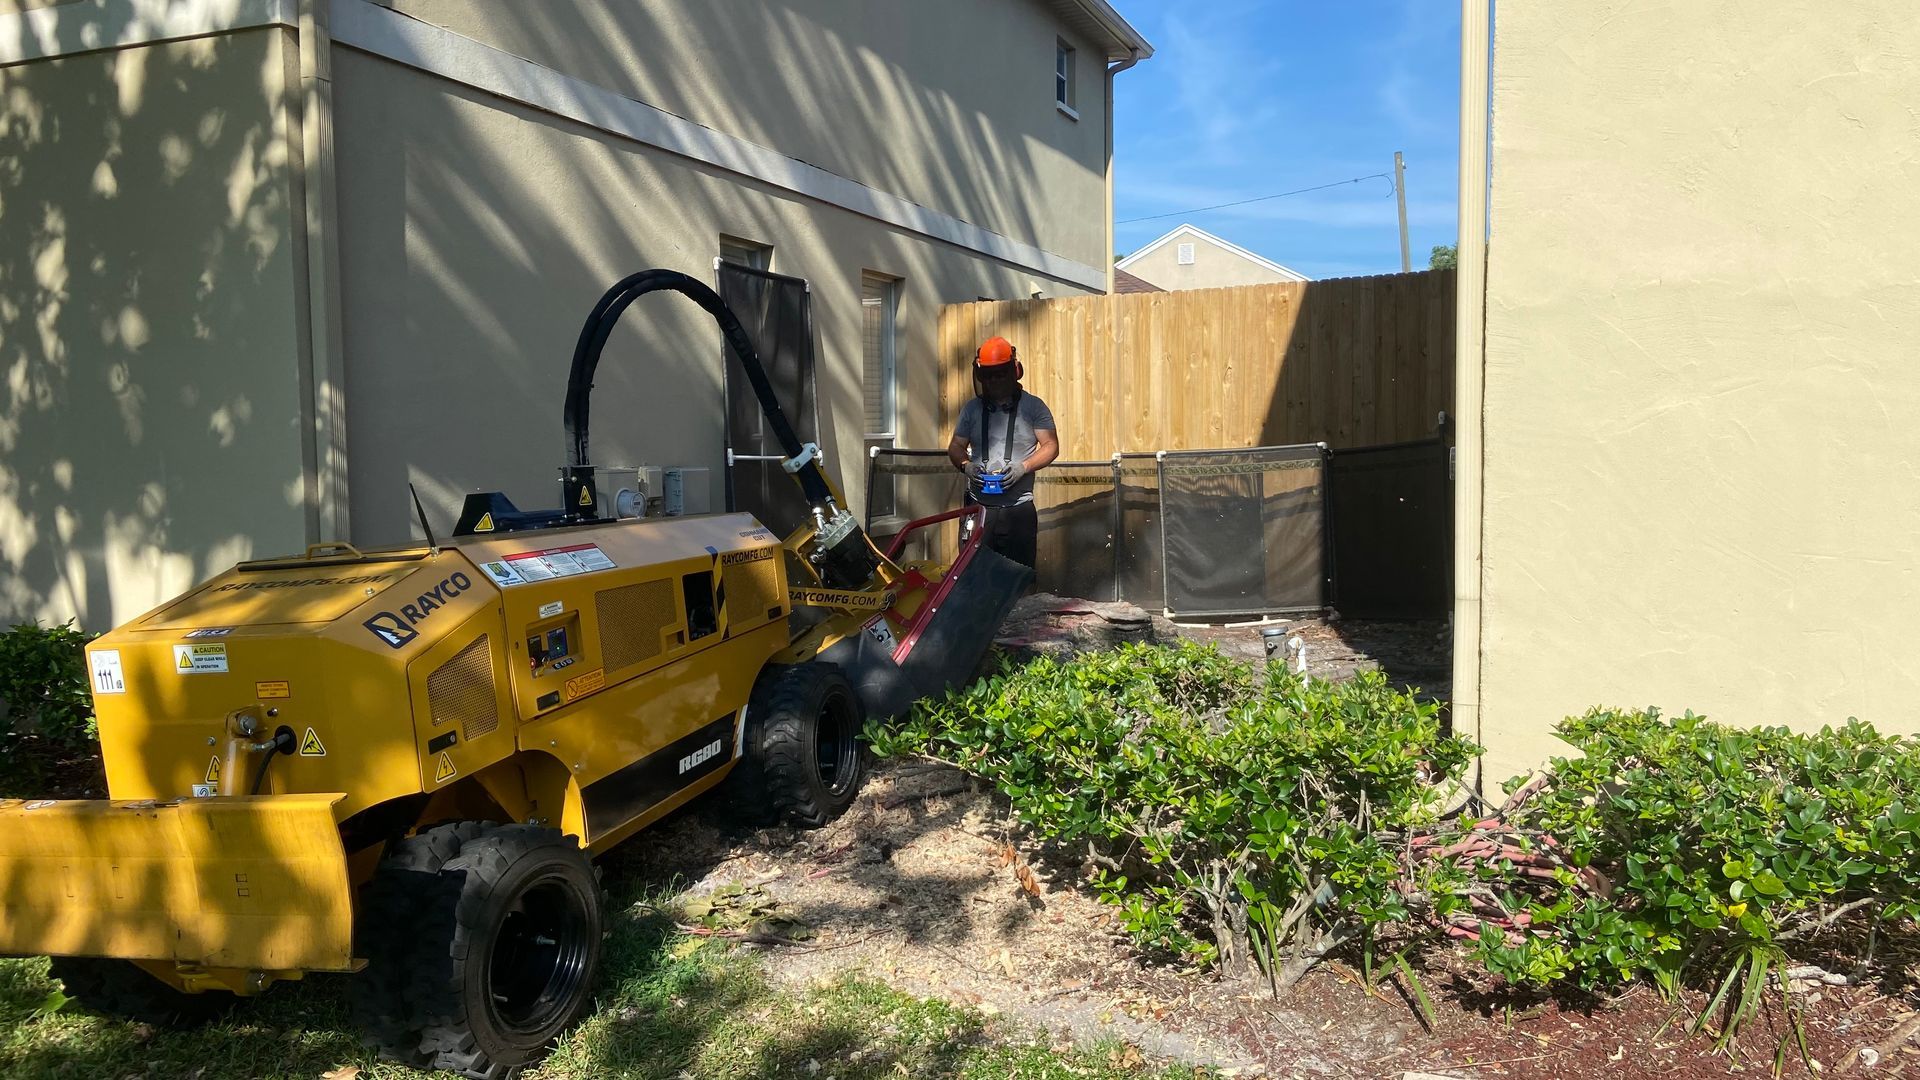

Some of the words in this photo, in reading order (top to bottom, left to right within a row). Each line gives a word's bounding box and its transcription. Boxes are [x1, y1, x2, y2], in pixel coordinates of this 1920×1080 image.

[722, 546, 774, 566] RAYCOMFG.COM
[400, 572, 471, 625] RAYCO
[788, 591, 877, 606] RAYCOMFG.COM
[199, 646, 224, 654] CAUTION
[679, 738, 721, 775] RG80
